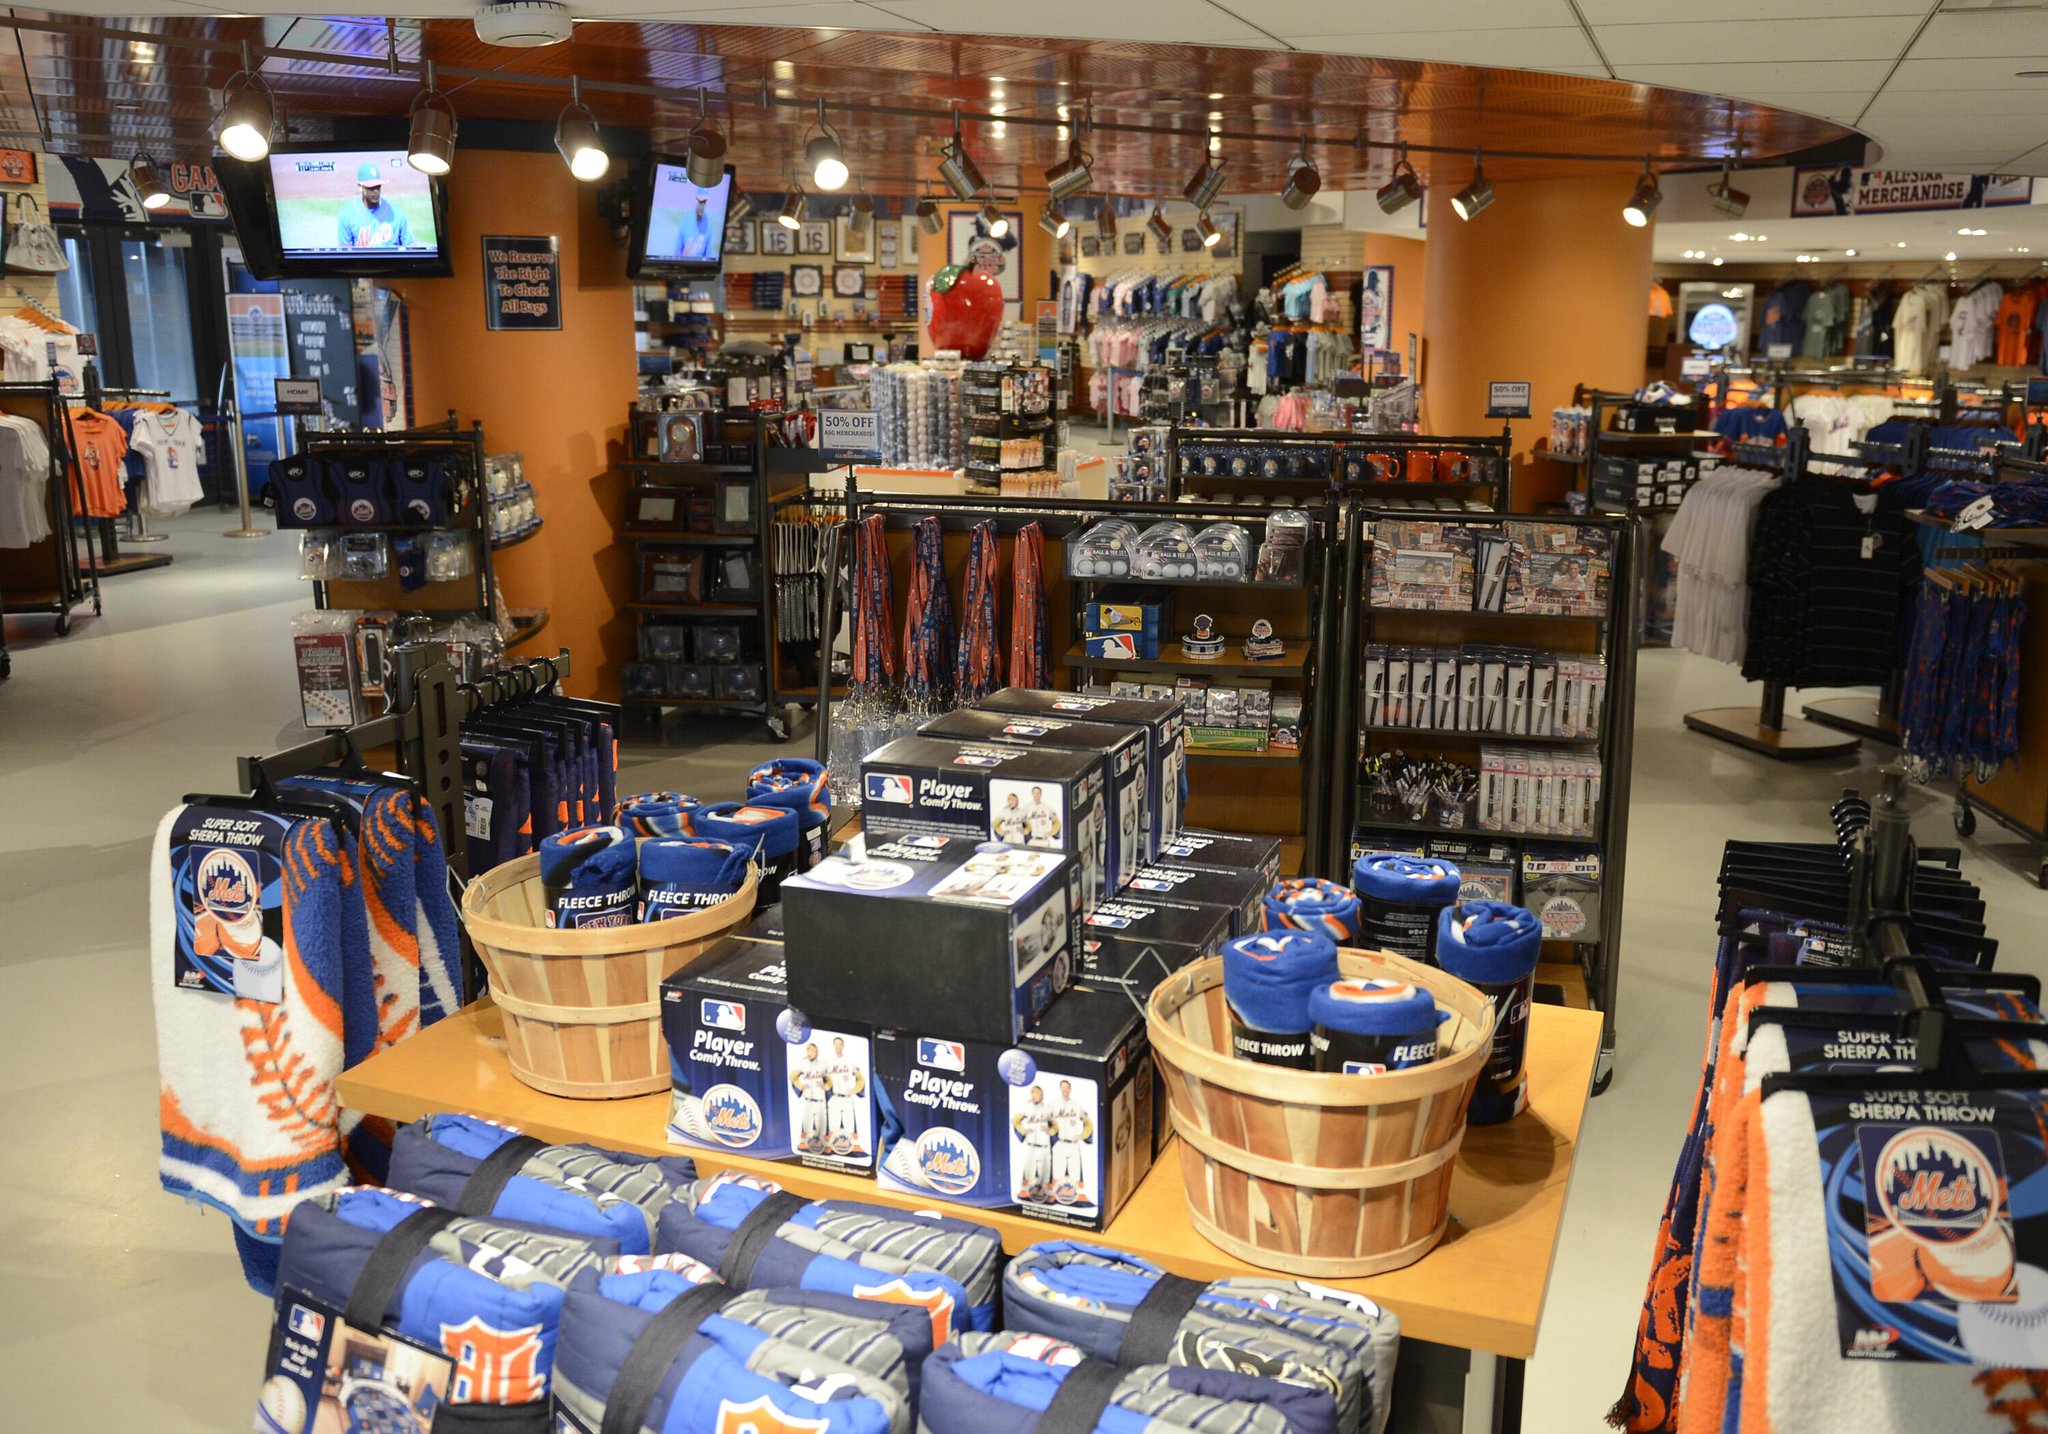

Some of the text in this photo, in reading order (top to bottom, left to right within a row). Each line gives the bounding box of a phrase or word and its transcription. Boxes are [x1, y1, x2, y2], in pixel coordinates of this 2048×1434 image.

[1858, 181, 1965, 205] MERCHANDISE
[488, 250, 555, 264] We Reserve
[495, 266, 550, 283] The Right
[497, 282, 549, 297] To Check
[501, 299, 548, 317] All Bags
[825, 416, 874, 428] 50% OFF
[919, 779, 973, 799] Player
[919, 796, 950, 810] Comfy
[202, 817, 261, 833] SUPER SOFT
[189, 831, 264, 846] SHERPA THROW
[1431, 843, 1467, 853] TICKET ALBUM
[208, 877, 246, 903] Mets
[648, 889, 689, 904] FLEECE
[558, 896, 603, 909] FLEECE
[693, 1029, 754, 1058] Player
[1837, 1030, 1891, 1044] SUPER
[689, 1049, 724, 1067] Comfy
[1261, 1042, 1305, 1058] THROW
[1393, 1042, 1436, 1062] FLEECE
[1823, 1044, 1890, 1060] SHERPA
[908, 1069, 973, 1098] Player
[903, 1089, 941, 1109] Comfy
[1864, 1090, 1970, 1105] SUPER SOFT
[712, 1107, 751, 1131] Mets
[1849, 1103, 1995, 1123] SHERPA THROW
[927, 1152, 968, 1177] Mets
[1898, 1170, 1977, 1212] Mets
